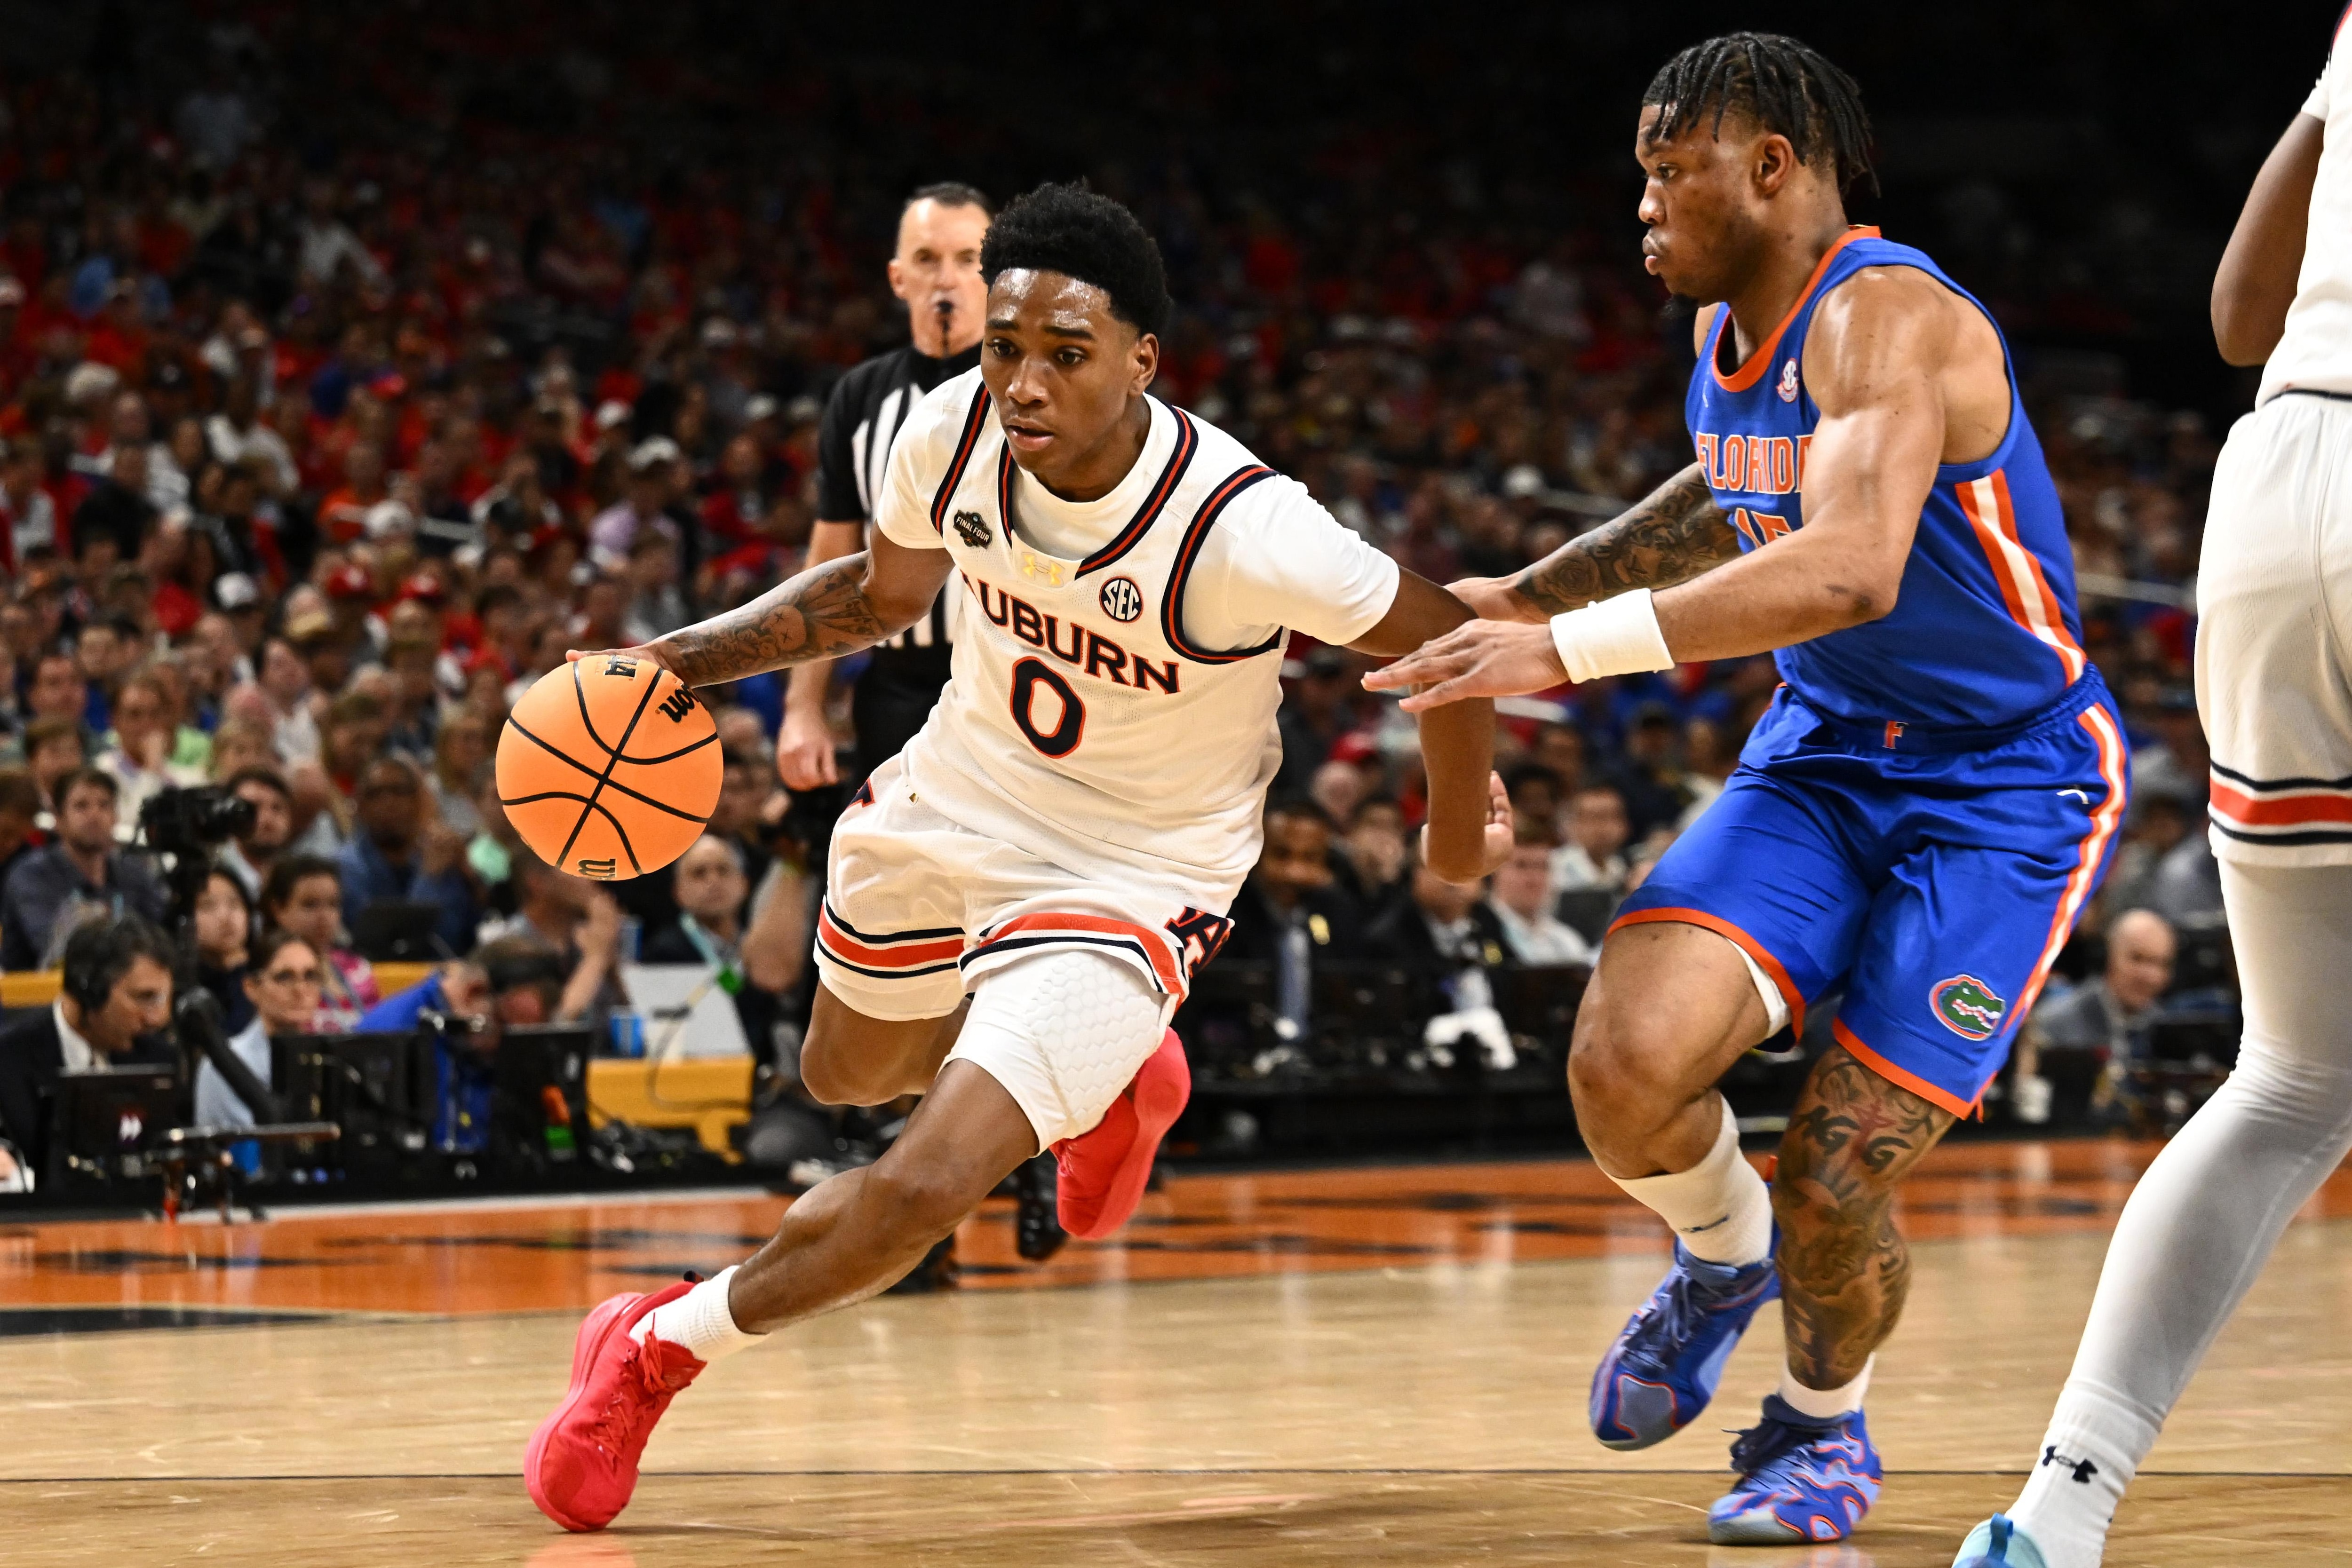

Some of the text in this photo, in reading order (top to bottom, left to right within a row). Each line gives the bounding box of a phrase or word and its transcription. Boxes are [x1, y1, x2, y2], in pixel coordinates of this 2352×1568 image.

[956, 516, 990, 543] FINAL FOUR
[1103, 579, 1140, 621] SEC
[960, 569, 1180, 695] UBURN
[1010, 656, 1087, 759] 0
[1882, 721, 1909, 749] F
